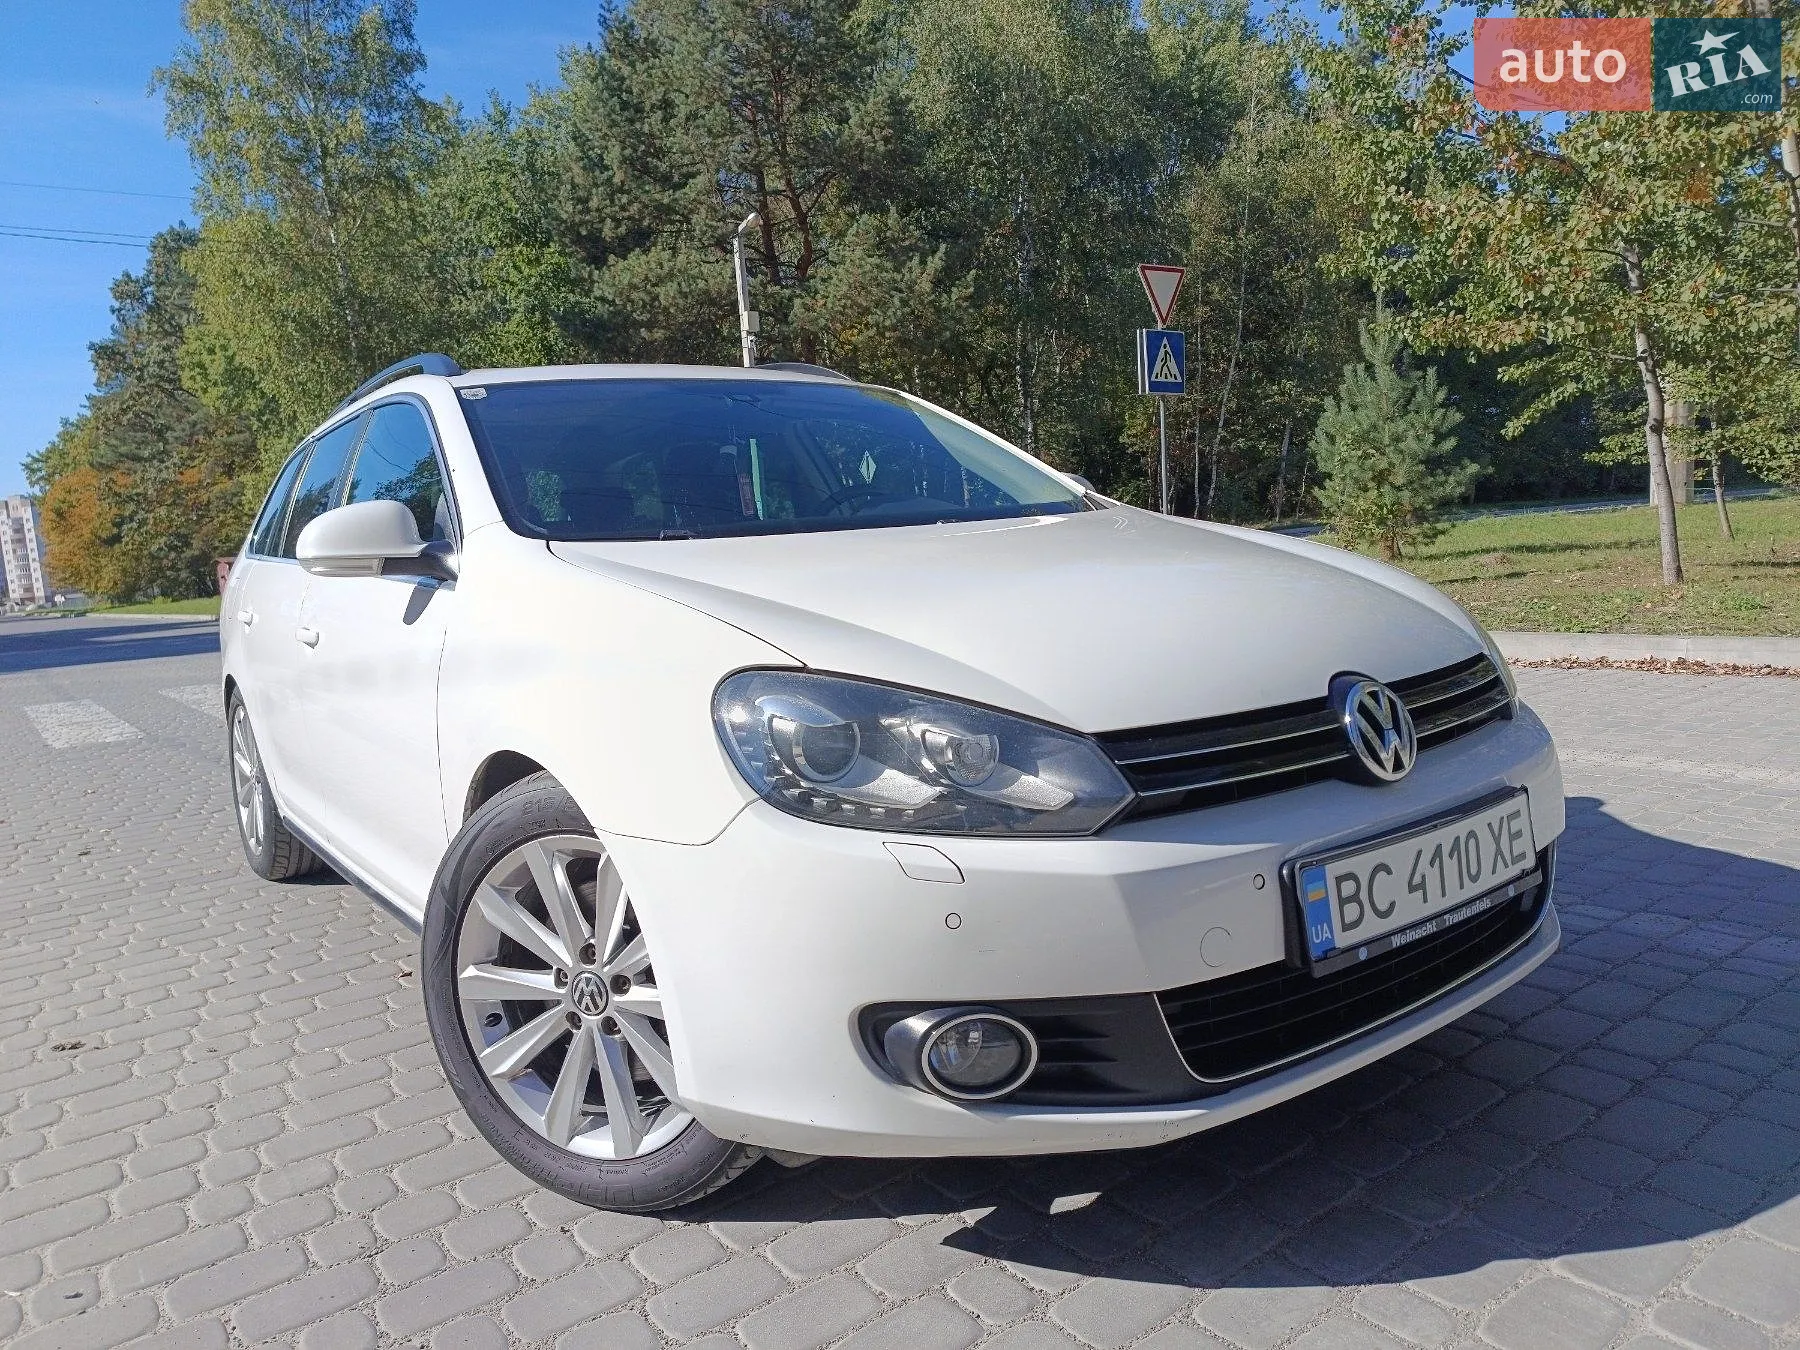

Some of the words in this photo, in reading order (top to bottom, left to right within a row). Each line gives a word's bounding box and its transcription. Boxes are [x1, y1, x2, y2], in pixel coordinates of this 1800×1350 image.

[1334, 862, 1397, 932] BC
[1407, 829, 1482, 904] 4110
[1487, 809, 1527, 875] XE
[1312, 925, 1332, 944] UA
[1390, 920, 1437, 948] Weinacht
